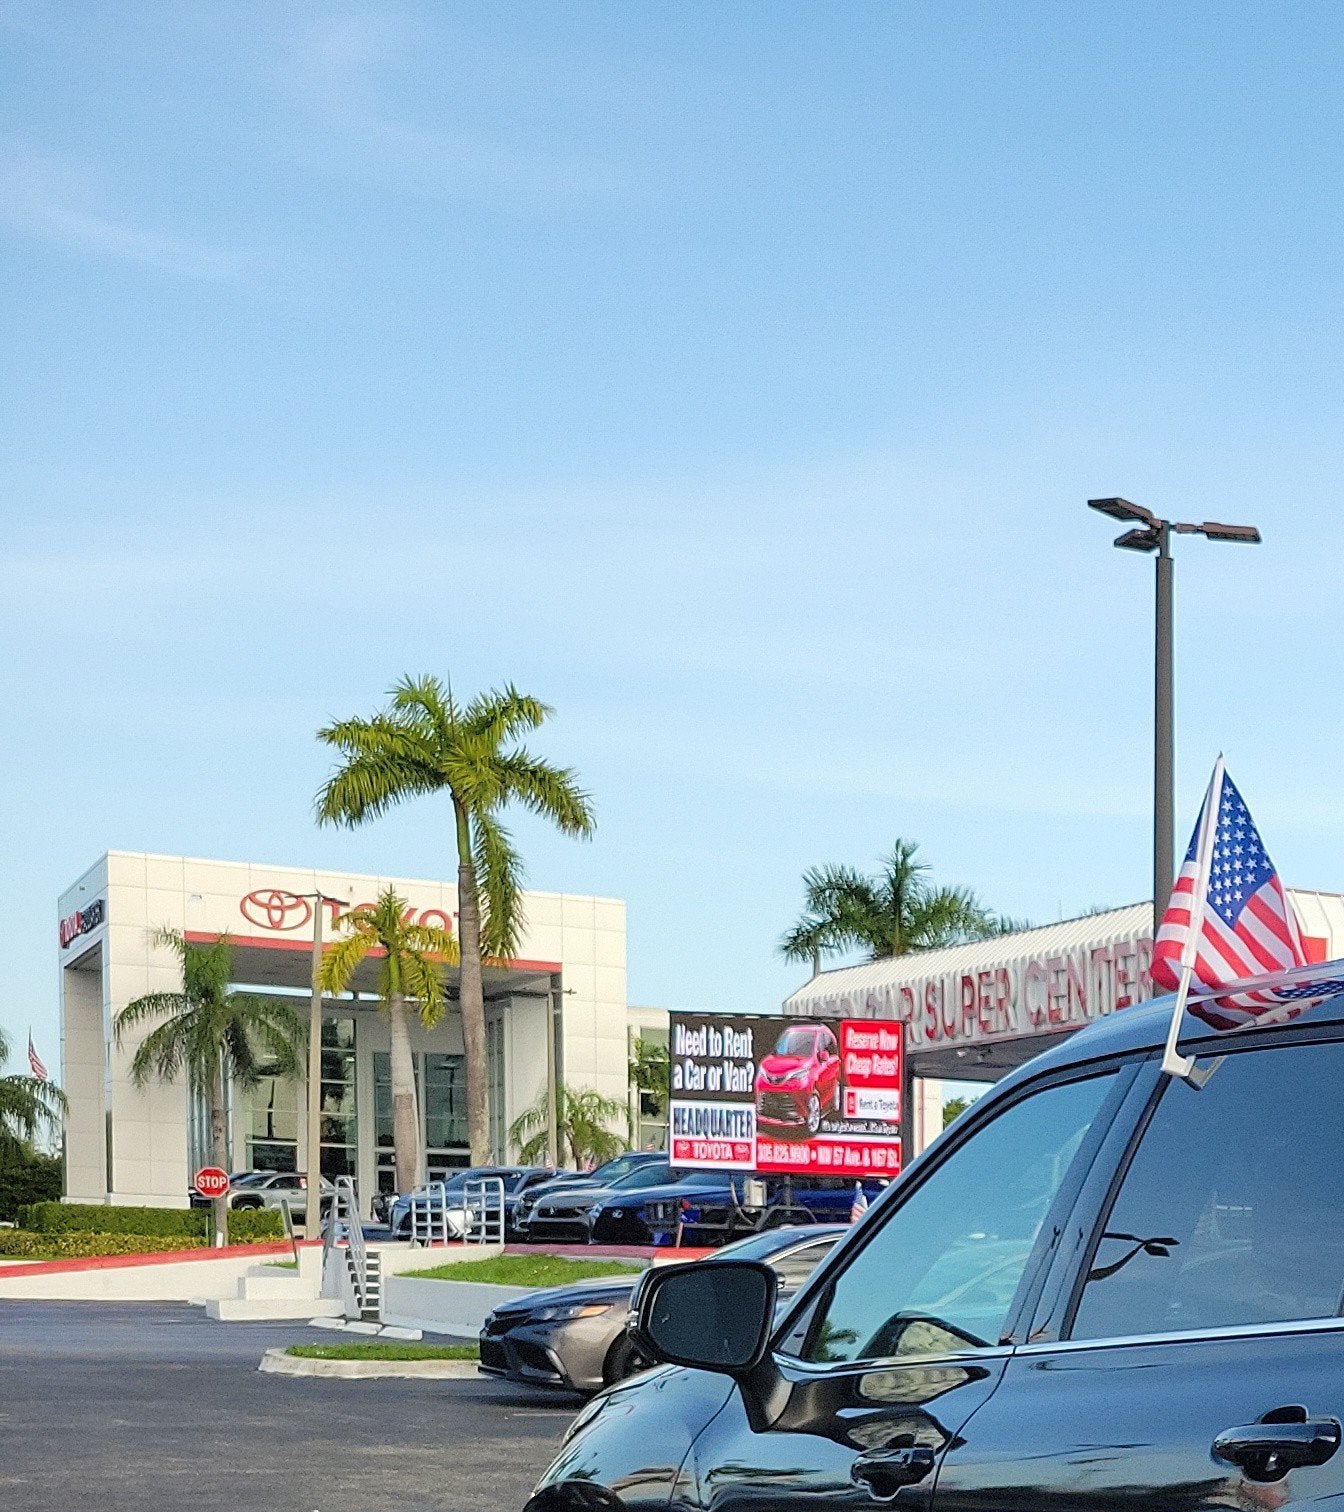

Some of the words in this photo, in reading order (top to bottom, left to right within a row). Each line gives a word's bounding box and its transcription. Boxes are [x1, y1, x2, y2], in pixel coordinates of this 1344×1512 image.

[925, 967, 1017, 1041] SUPER
[1023, 938, 1153, 1027] CENTER
[675, 1023, 707, 1057] Need
[708, 1025, 722, 1058] to
[723, 1025, 754, 1059] Rent
[673, 1063, 683, 1090] a
[684, 1058, 707, 1091] Car
[707, 1064, 723, 1092] or
[723, 1060, 755, 1093] Van?
[673, 1107, 754, 1139] HEADQUARTER
[692, 1142, 734, 1161] TOYOTA
[198, 1175, 227, 1189] STOP
